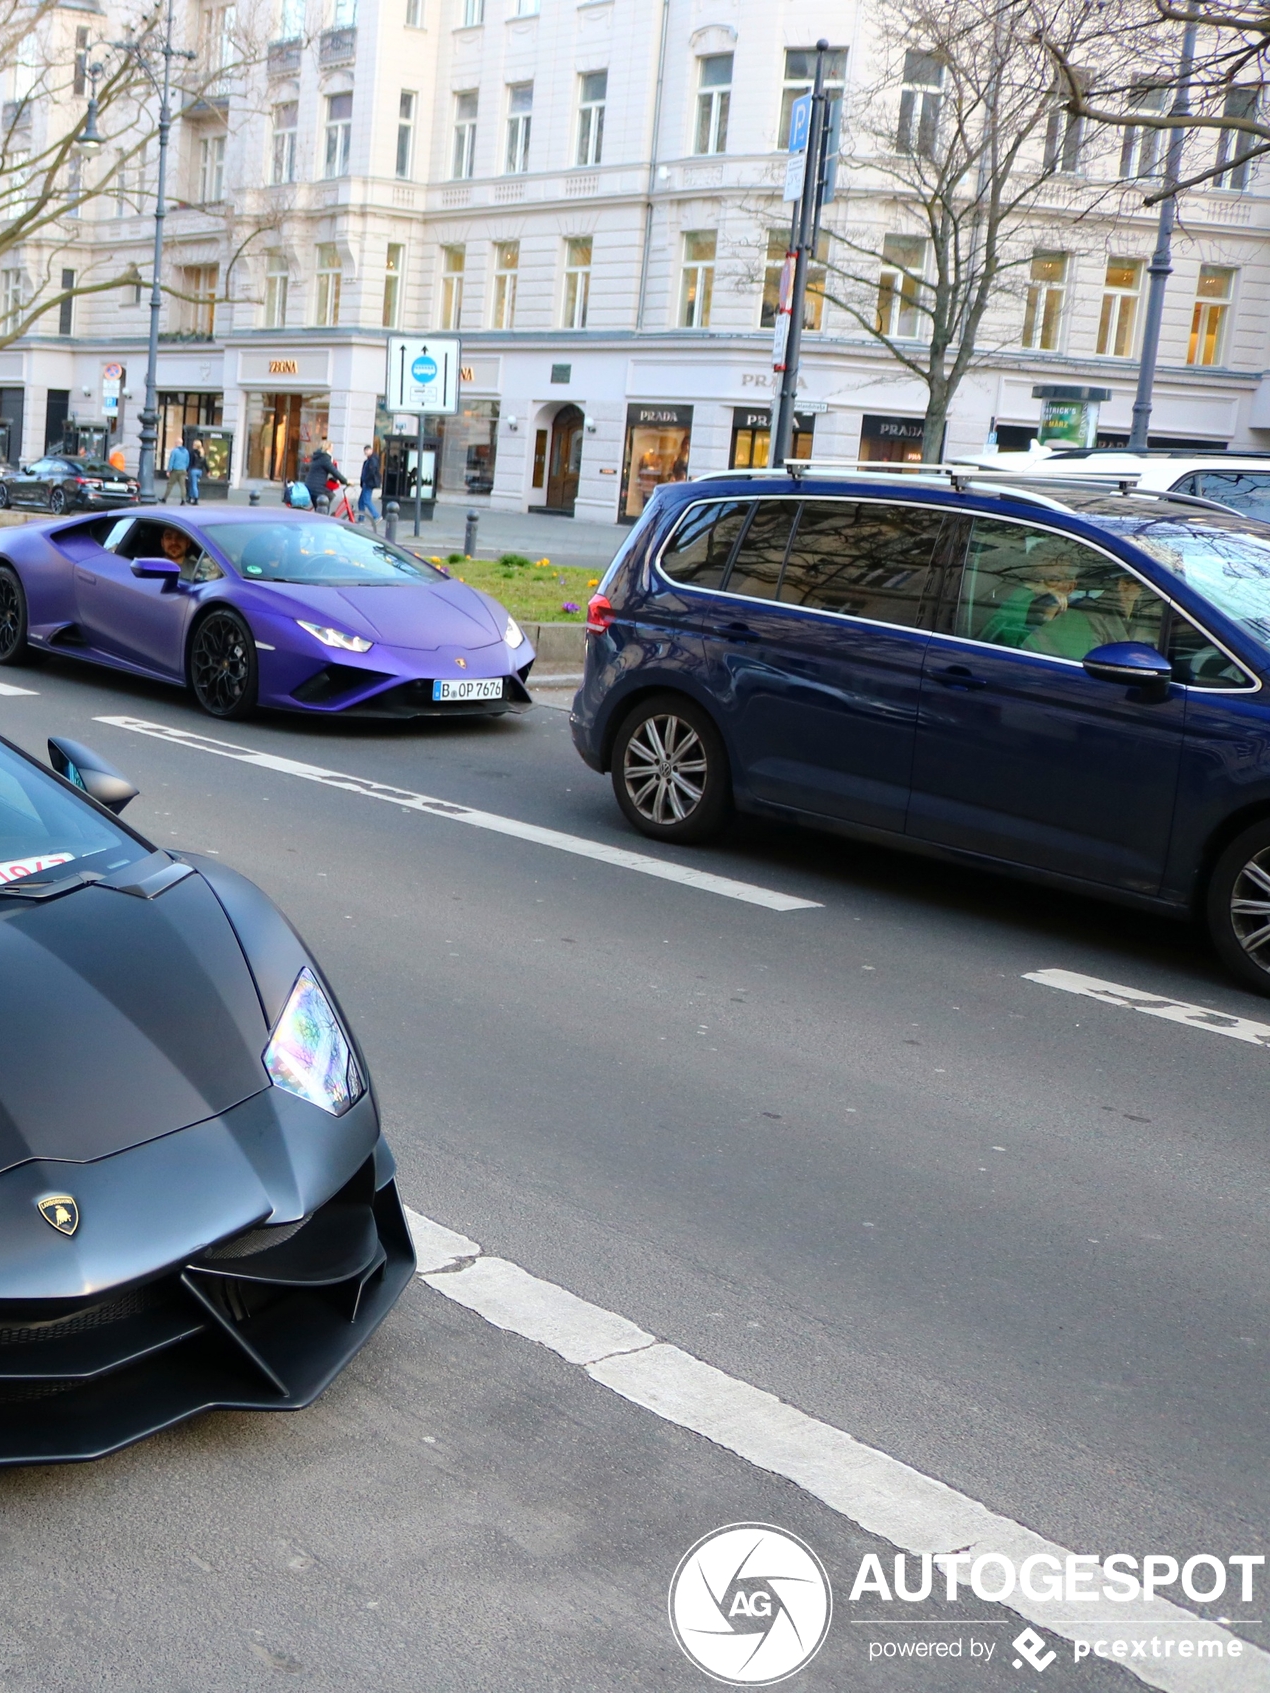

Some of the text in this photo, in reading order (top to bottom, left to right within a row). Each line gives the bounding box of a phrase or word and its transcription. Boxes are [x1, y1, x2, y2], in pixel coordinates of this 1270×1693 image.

[269, 360, 298, 373] ZEGNA
[741, 374, 808, 389] PRA
[640, 410, 678, 422] PRADA
[747, 414, 800, 429] PRA
[442, 681, 501, 698] B OP 7676
